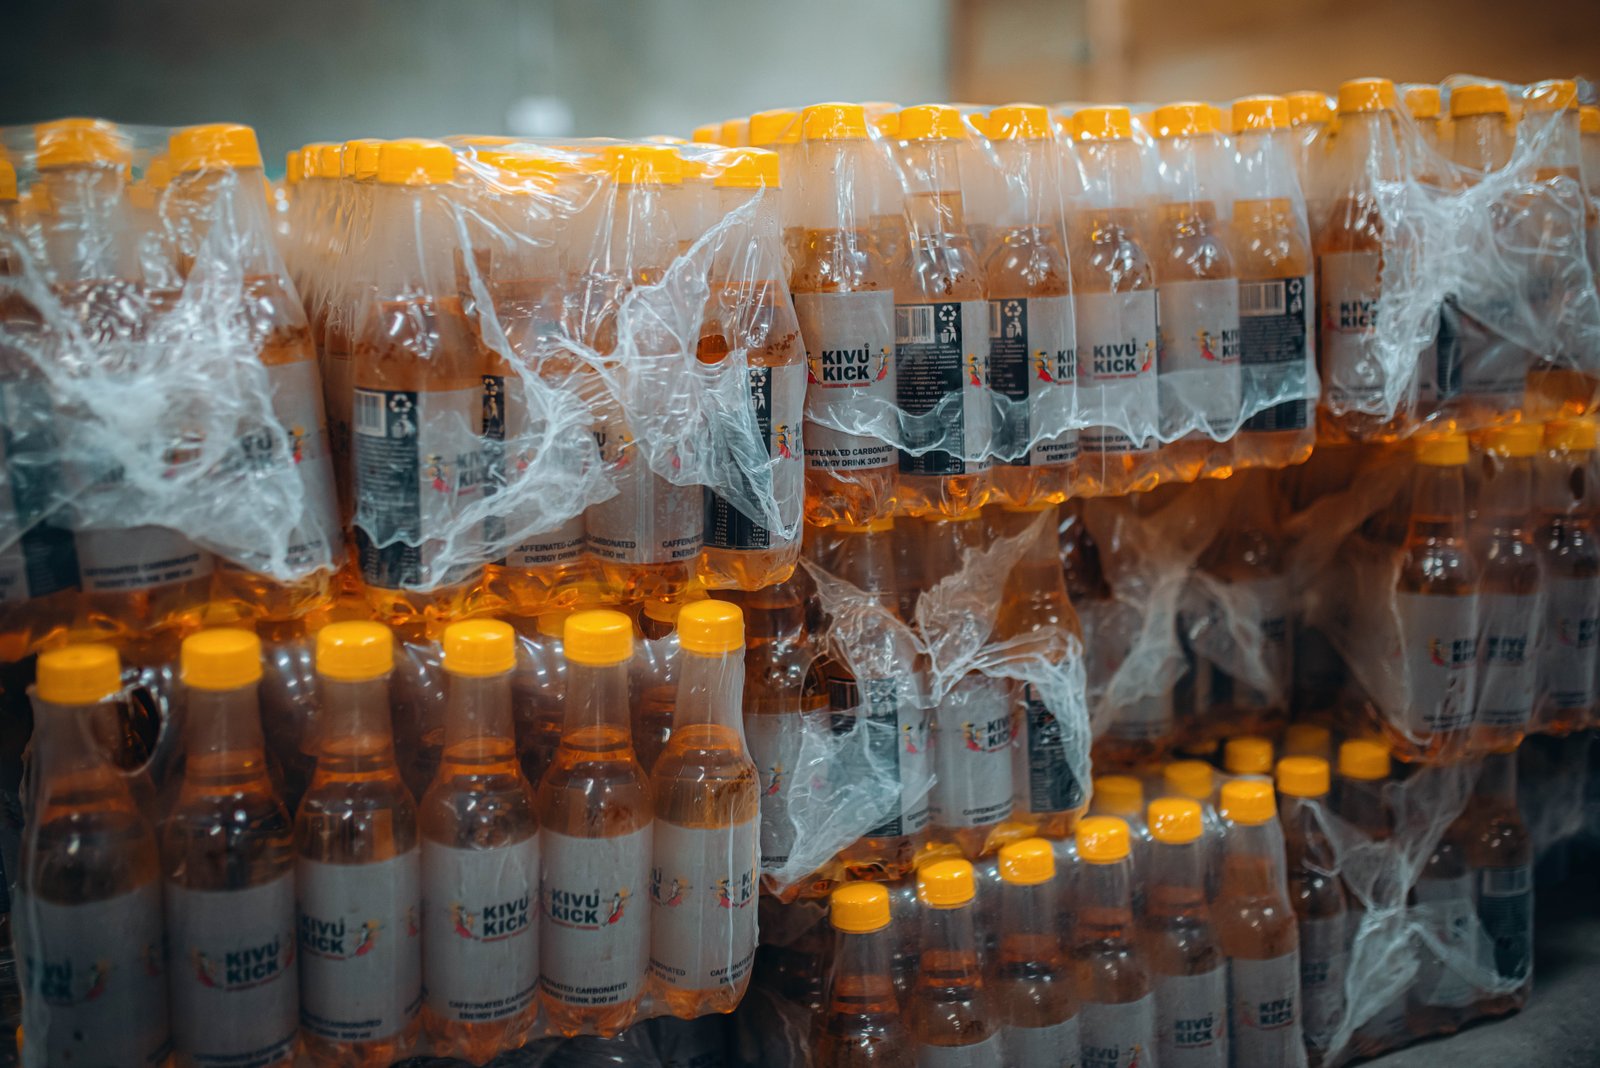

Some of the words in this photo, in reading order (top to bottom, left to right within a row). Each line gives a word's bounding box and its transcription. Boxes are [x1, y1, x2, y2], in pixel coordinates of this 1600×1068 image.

[822, 348, 870, 365] KIVU
[1093, 343, 1136, 359] KIVU
[822, 365, 870, 381] KICK
[1093, 358, 1136, 373] KICK
[842, 459, 866, 467] DRINK
[867, 457, 880, 465] 300
[483, 894, 529, 920] KIVU
[552, 888, 599, 909] KIVU
[483, 911, 528, 936] KICK
[551, 903, 599, 924] KICK
[225, 942, 280, 967] KIVU
[225, 960, 279, 984] KICK
